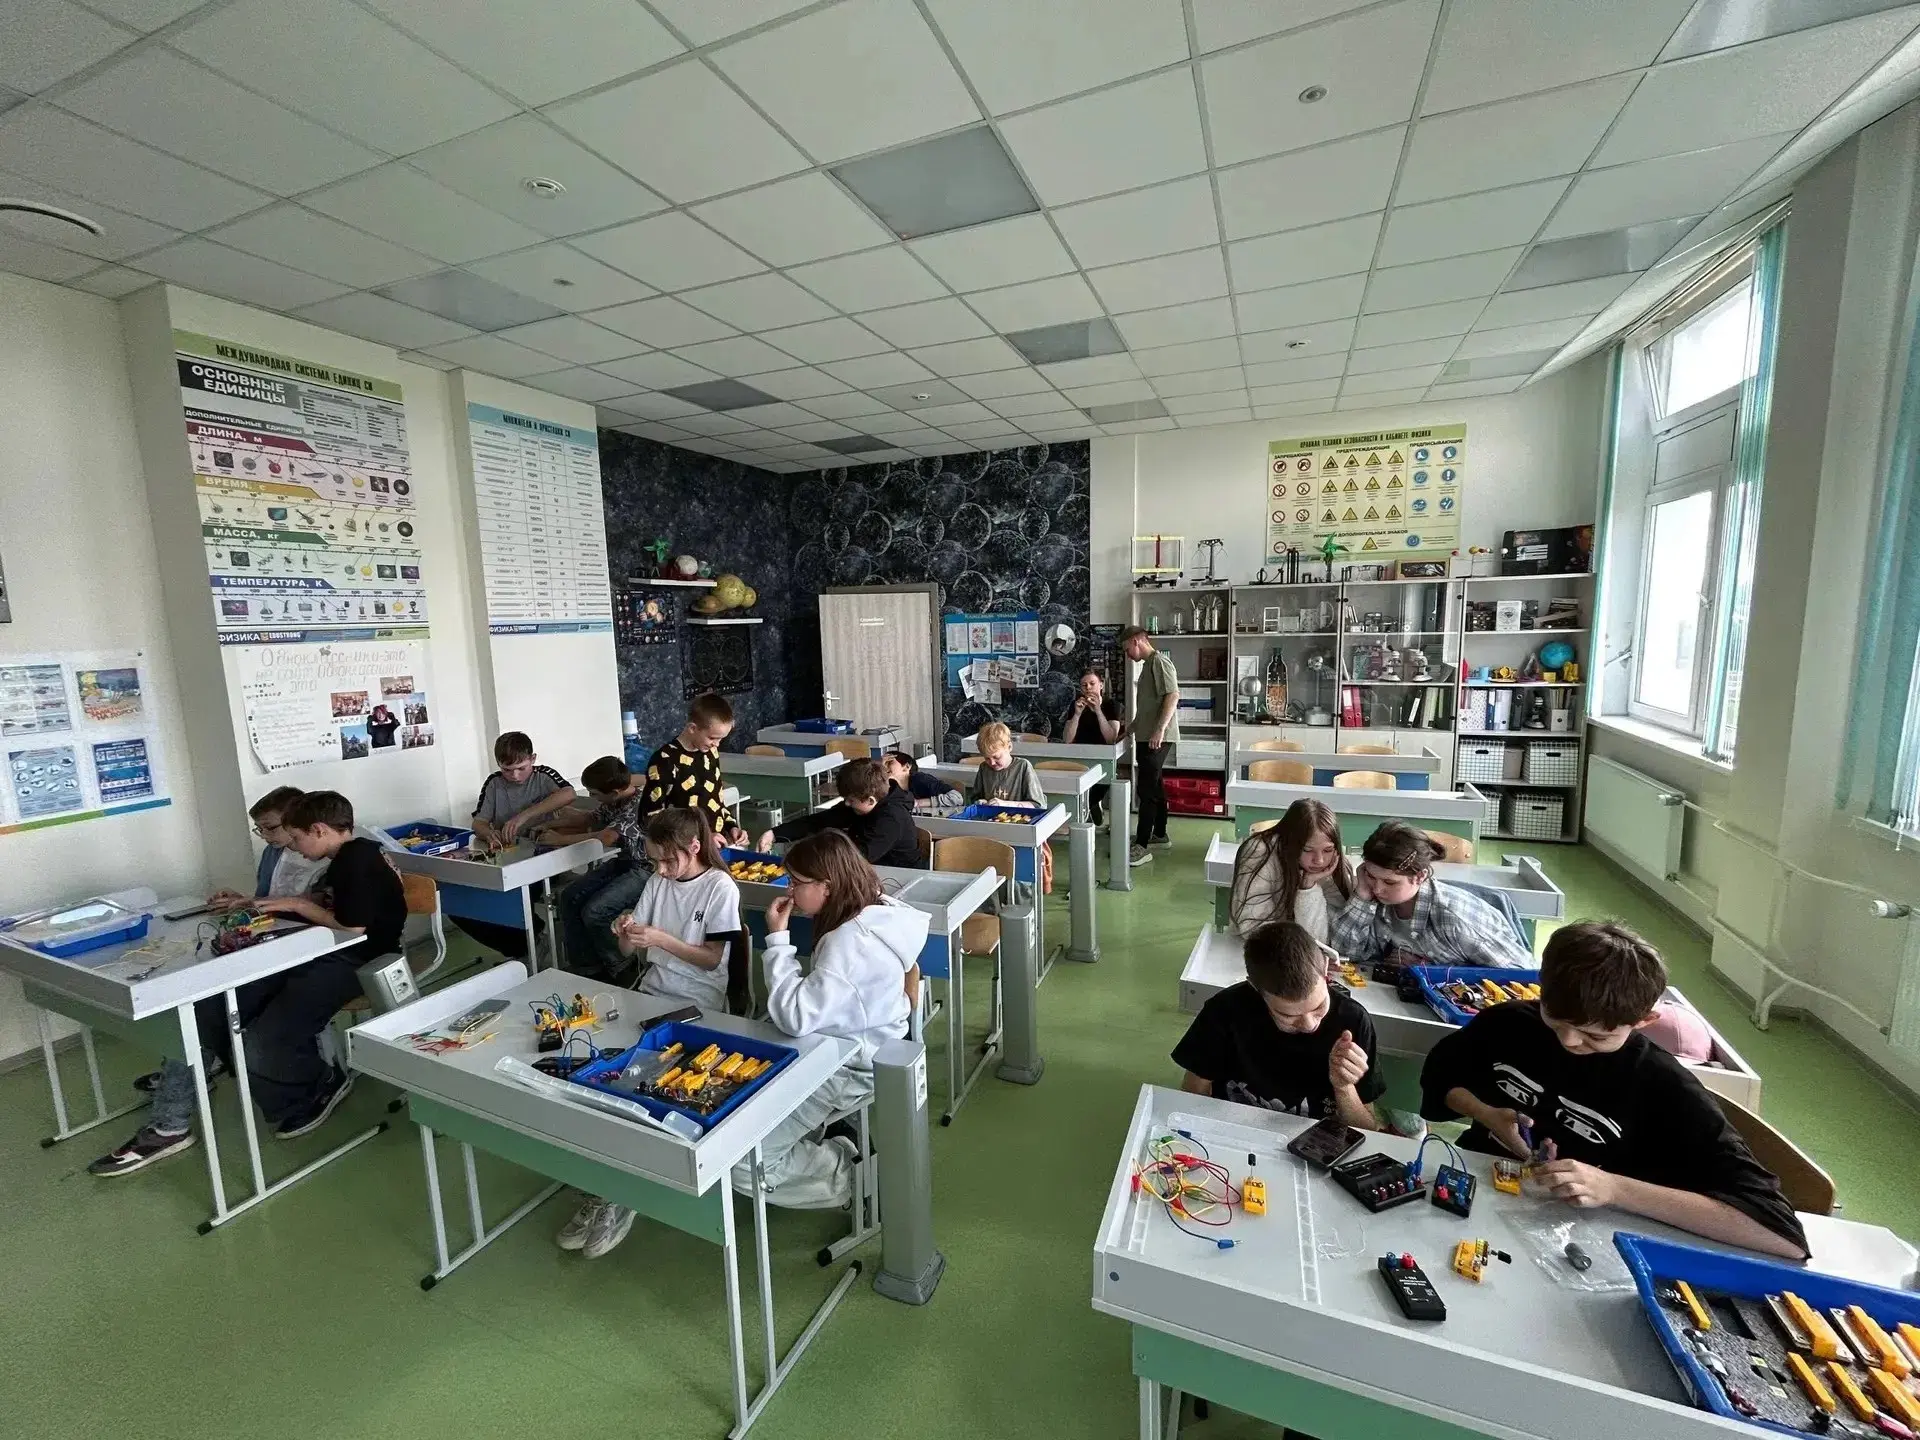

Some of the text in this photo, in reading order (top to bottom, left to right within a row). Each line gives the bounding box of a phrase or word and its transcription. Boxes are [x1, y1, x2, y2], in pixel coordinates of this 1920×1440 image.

[216, 344, 373, 391] МЕЖДУНАРОДНАЯ СИСТЕМА ЕДИНИЦ СИ
[191, 365, 285, 393] ОСНОВНЫЕ
[203, 379, 286, 404] ЕДИНИЦЫ
[185, 409, 262, 428] ДОПОЛНИТЕЛЬНЫЕ
[198, 425, 246, 441] ДЛИНА,
[1300, 440, 1320, 448] ПРАВИЛА
[1322, 438, 1342, 446] ТЕХНИКИ
[1343, 434, 1378, 445] БЕЗОПАСНОСТИ
[1385, 431, 1408, 440] КАБИНЕТЕ
[1411, 430, 1431, 438] ФИЗИКИ
[206, 477, 252, 490] ВРЕМЯ,
[213, 527, 260, 539] МАССА,
[220, 577, 310, 588] ТЕМПЕРАТУРА,
[218, 632, 260, 642] ФИЗИКА
